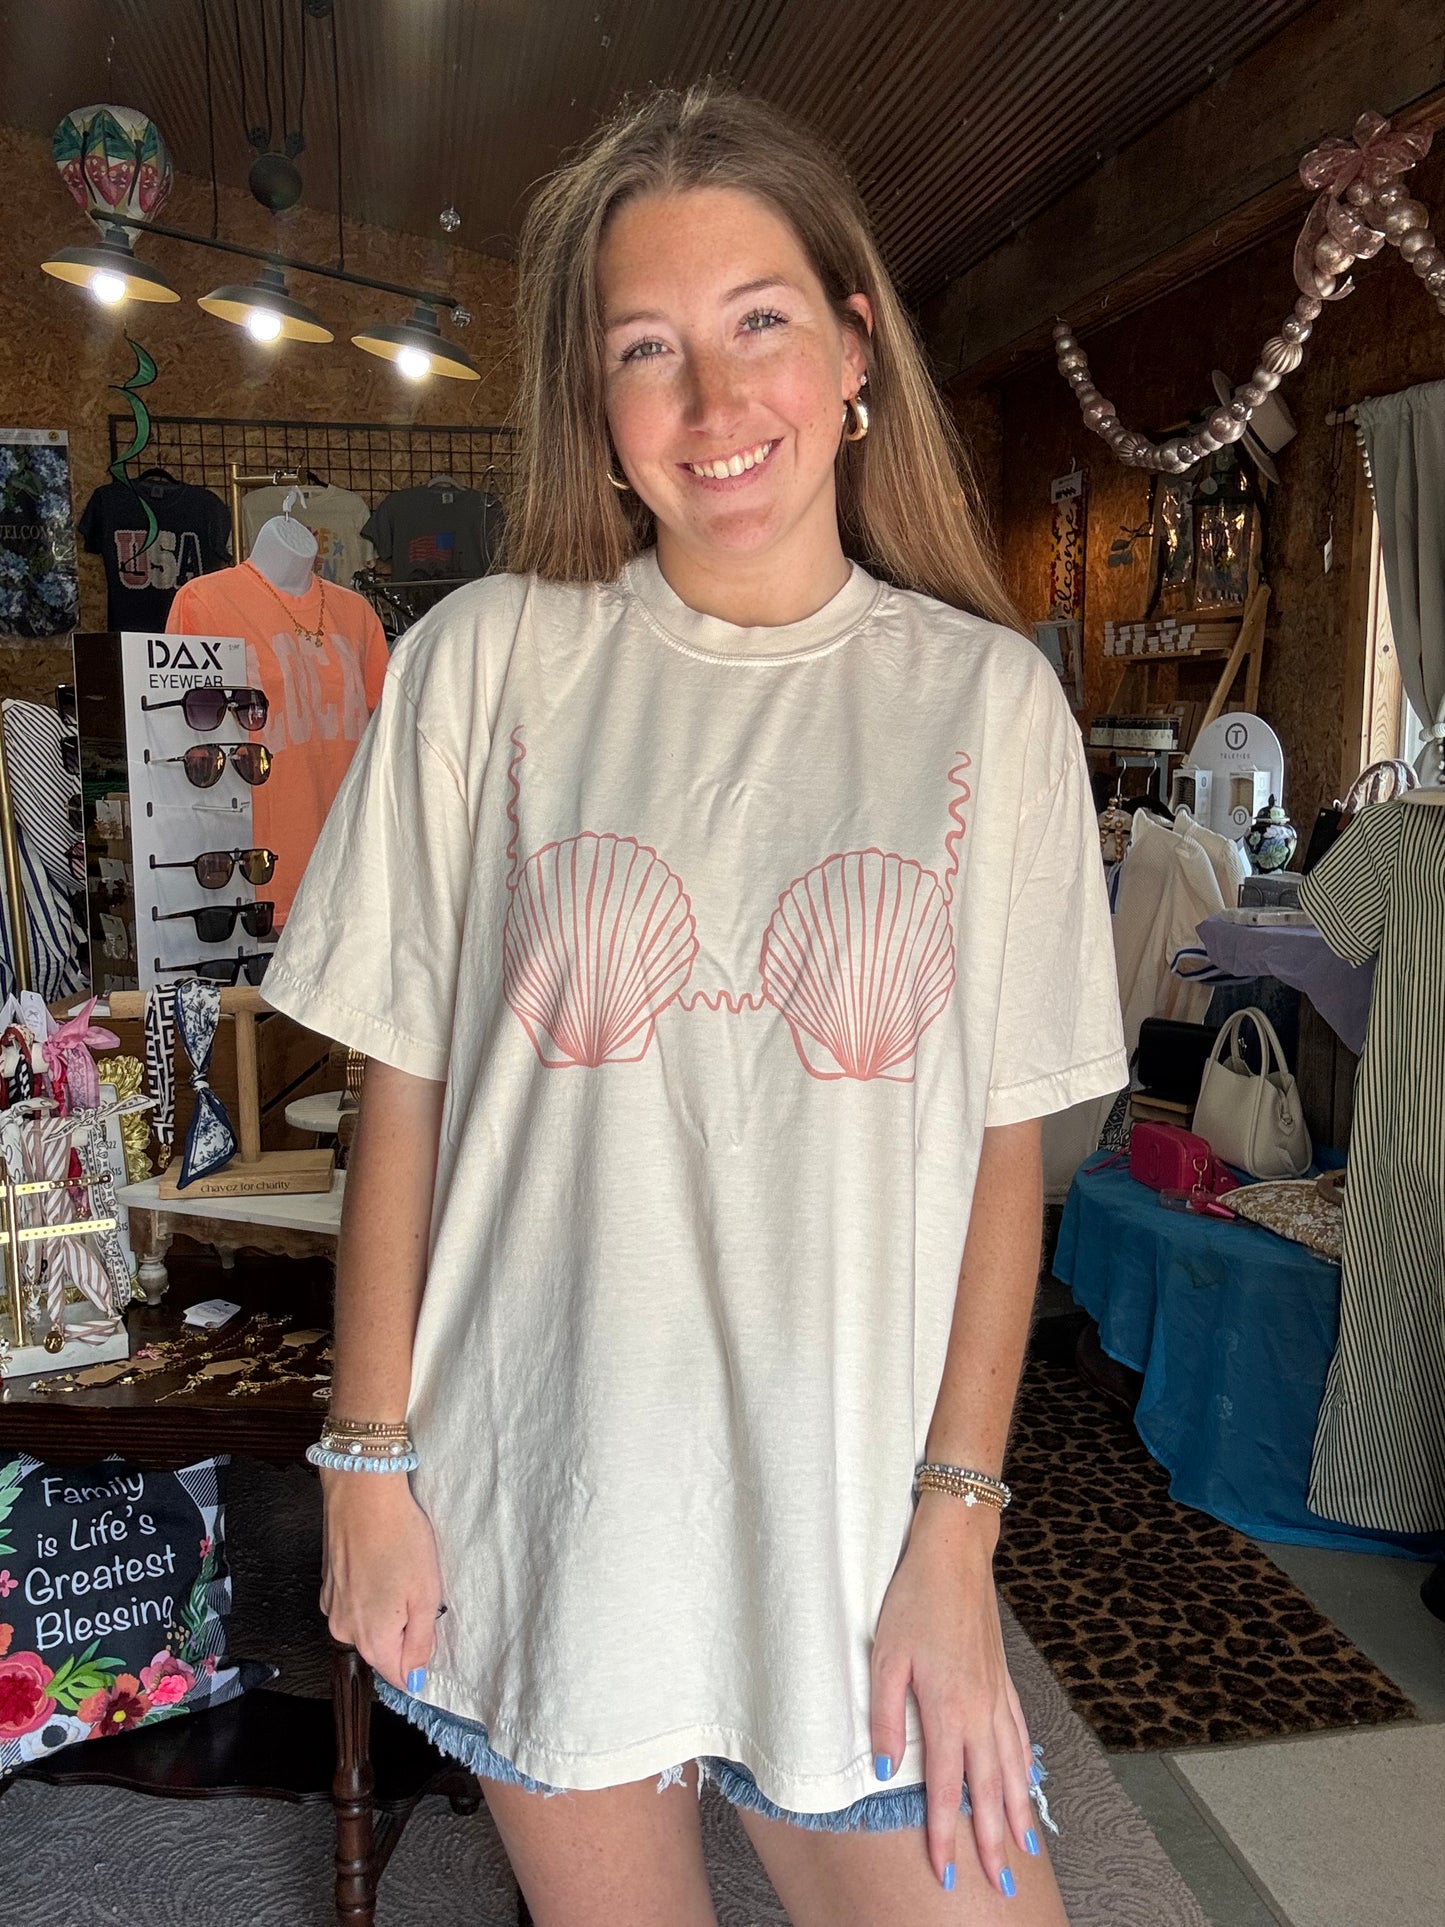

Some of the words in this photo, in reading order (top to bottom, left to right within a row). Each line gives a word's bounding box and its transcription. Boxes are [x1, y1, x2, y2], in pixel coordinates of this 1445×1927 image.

[114, 529, 203, 590] USA
[147, 639, 224, 671] DAX
[149, 673, 224, 689] EYEWEAR
[200, 1183, 238, 1193] chavez
[240, 1182, 255, 1191] for
[255, 1180, 291, 1191] charity
[41, 1472, 145, 1507] Family
[37, 1533, 58, 1559] is
[70, 1505, 157, 1551] Life's
[25, 1544, 176, 1606] Greatest
[36, 1595, 174, 1651] Blessing
